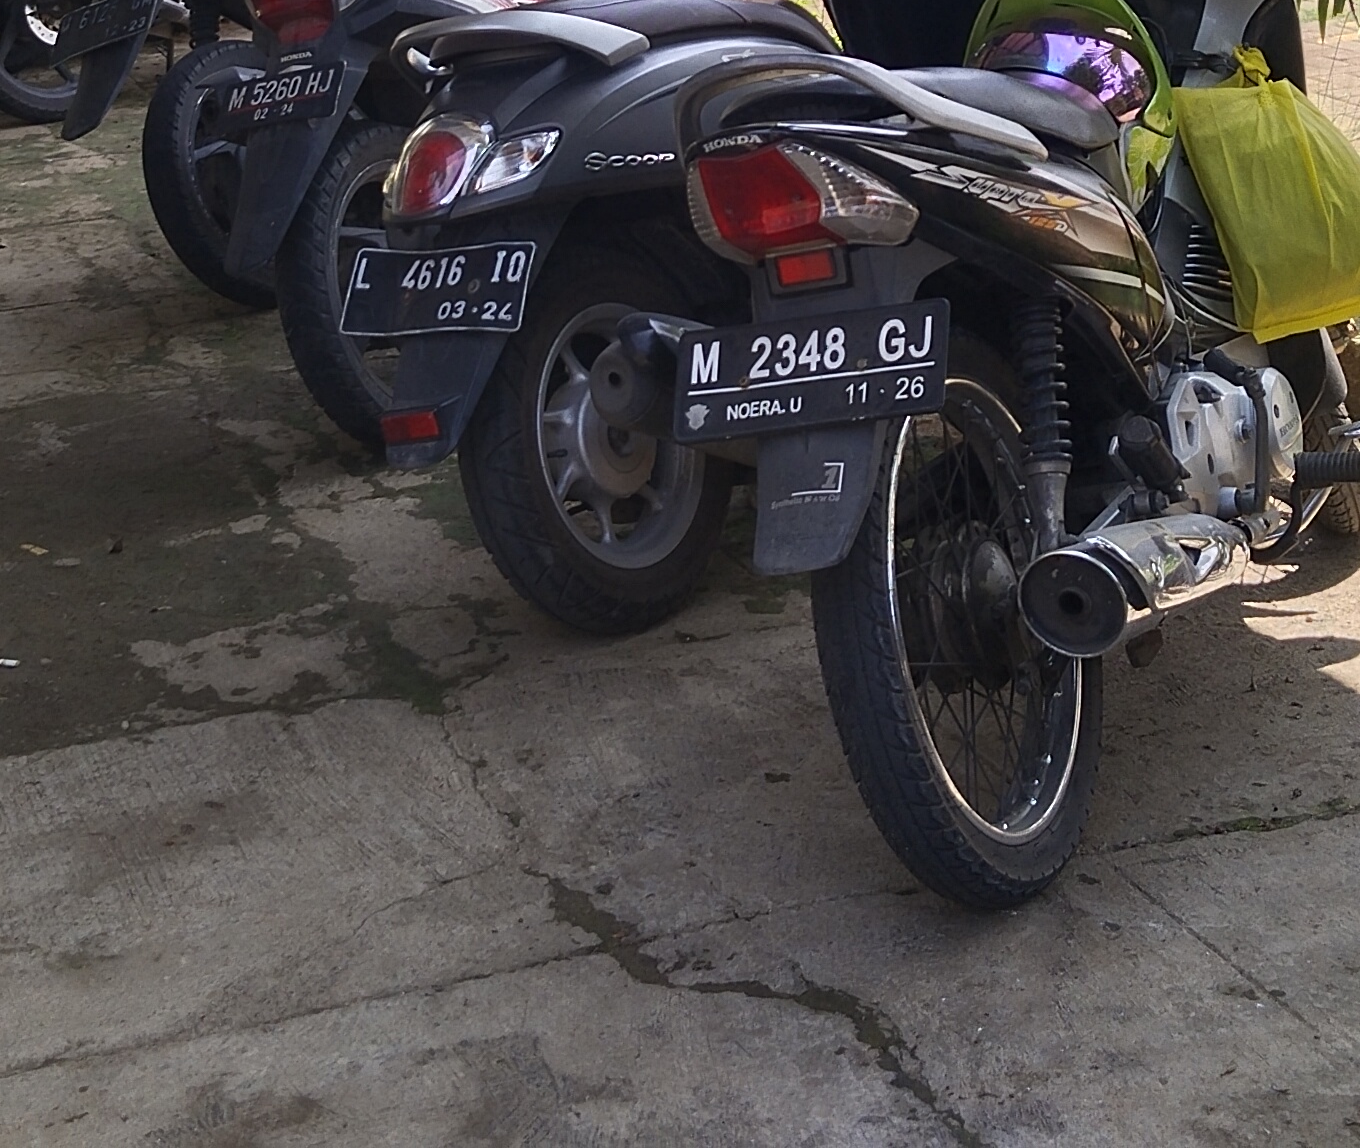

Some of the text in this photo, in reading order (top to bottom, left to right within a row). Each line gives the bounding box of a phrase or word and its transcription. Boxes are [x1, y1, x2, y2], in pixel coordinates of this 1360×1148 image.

[280, 51, 313, 63] HONDA
[228, 69, 335, 112] M 5260 HJ
[702, 134, 763, 153] HONDA
[355, 257, 371, 289] L
[401, 254, 466, 290] 4616
[691, 315, 933, 385] M 2348 GJ
[790, 396, 802, 413] U
